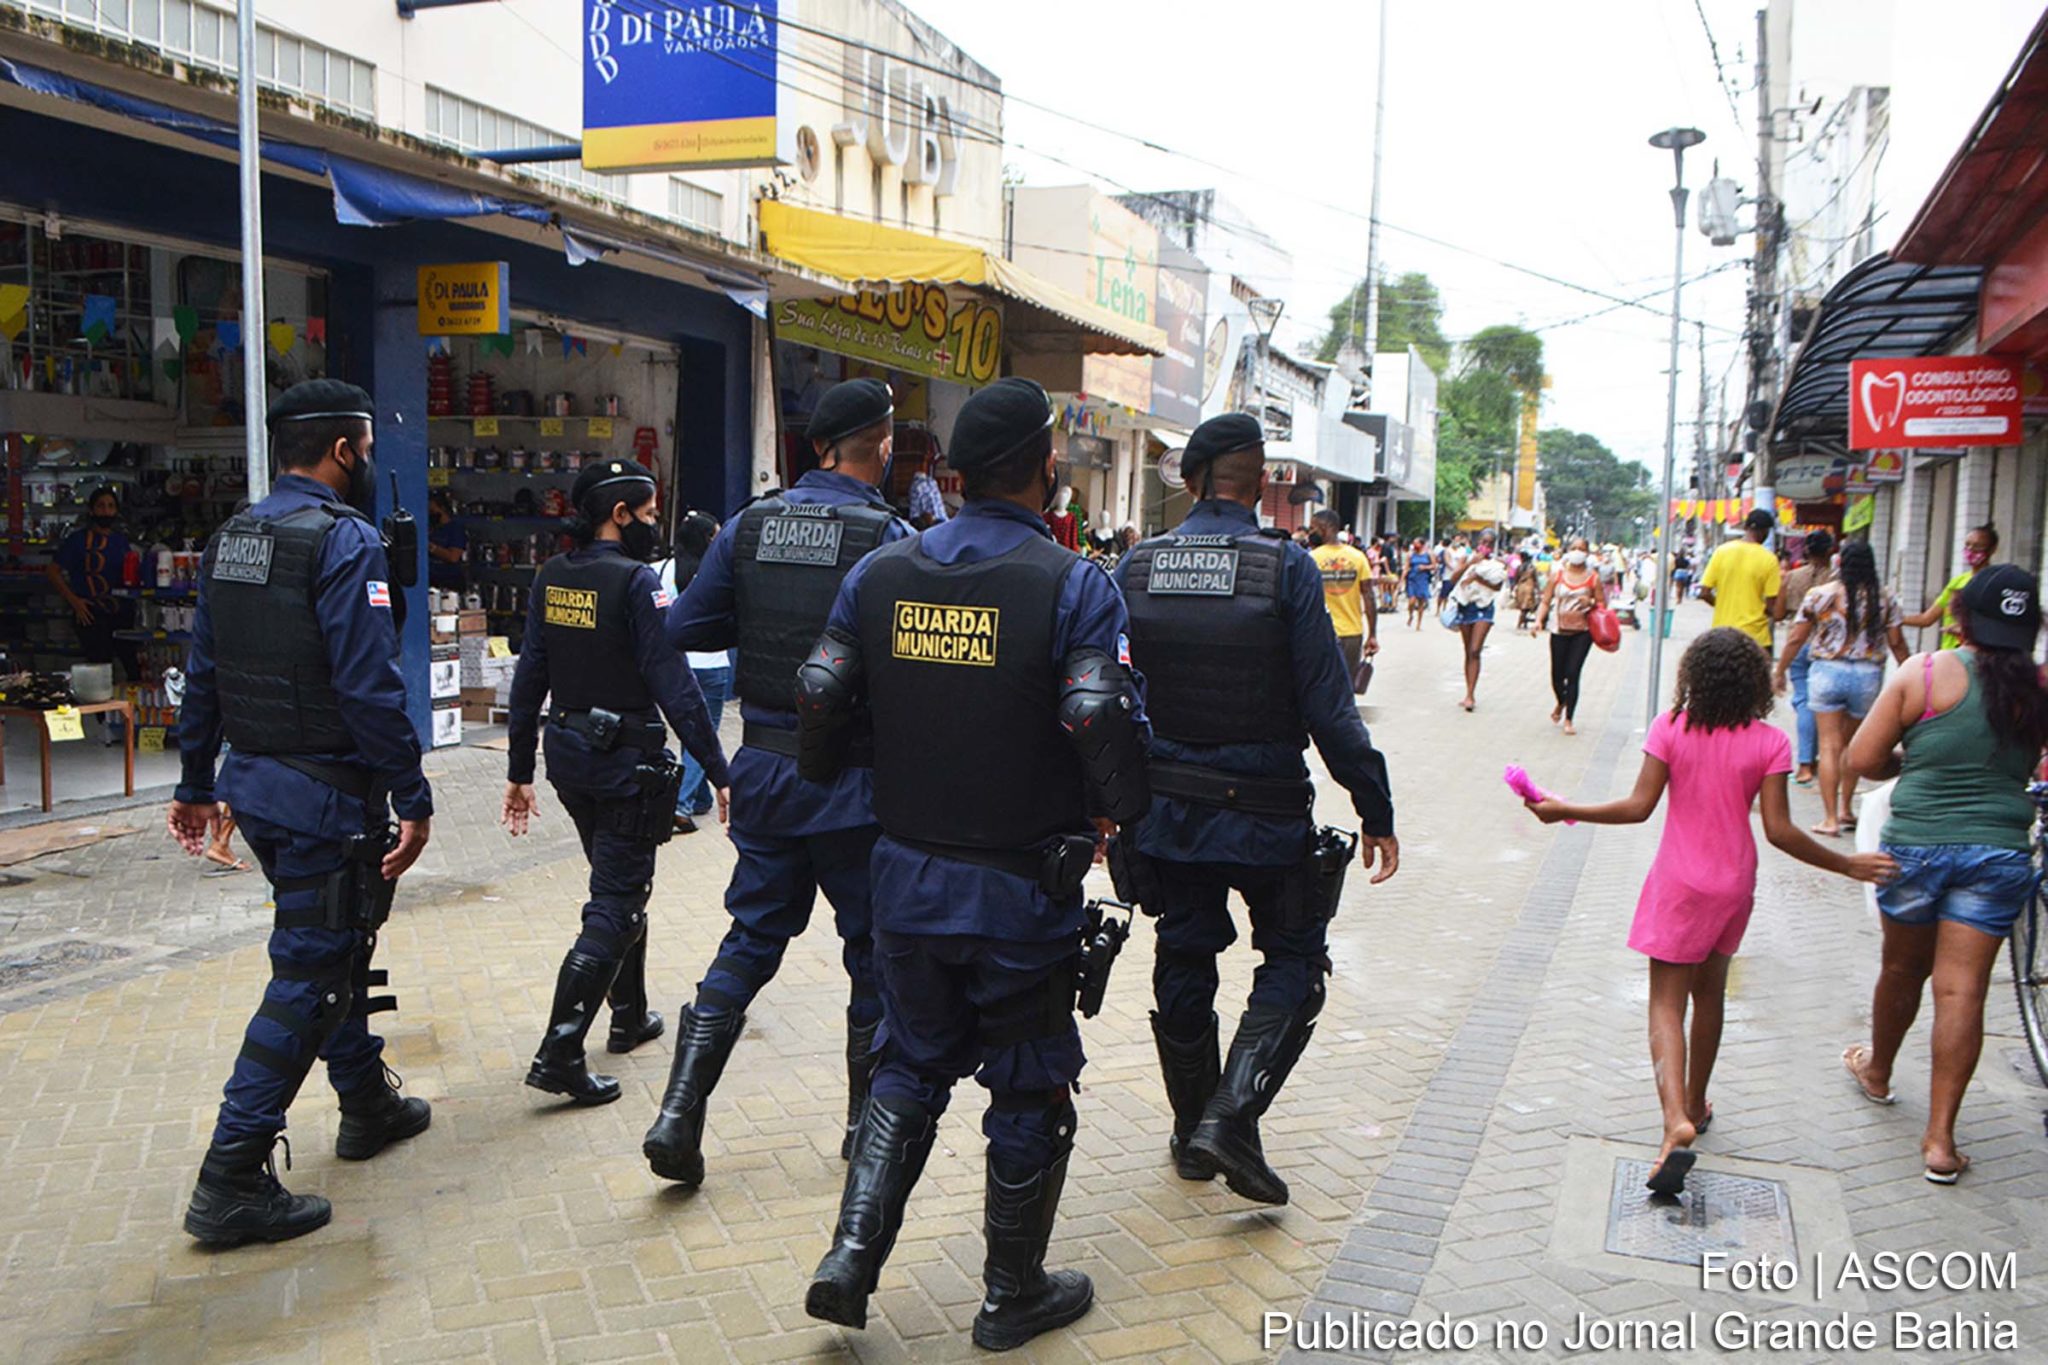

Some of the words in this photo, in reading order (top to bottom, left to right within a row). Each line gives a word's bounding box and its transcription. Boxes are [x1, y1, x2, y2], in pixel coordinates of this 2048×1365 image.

[621, 12, 654, 46] DI
[664, 2, 767, 41] PAULA
[663, 34, 769, 55] VARIEDADES
[434, 281, 450, 300] DI
[451, 280, 489, 299] PAULA
[1094, 254, 1148, 324] Lena
[779, 299, 815, 329] Sua
[949, 300, 1002, 384] 10
[1911, 366, 2011, 387] CONSULTÓRIO
[1905, 385, 2017, 406] ODONTOLÓGICO
[763, 519, 837, 549] GUARDA
[218, 535, 268, 566] GUARDA
[759, 548, 782, 559] CIVIL
[784, 549, 834, 563] MUNICIPAL
[1155, 552, 1232, 571] GUARDA
[1152, 572, 1229, 590] MUNICIPAL
[547, 589, 594, 610] GUARDA
[545, 606, 594, 626] MUNICIPAL
[899, 606, 992, 637] GUARDA
[896, 631, 993, 662] MUNICIPAL
